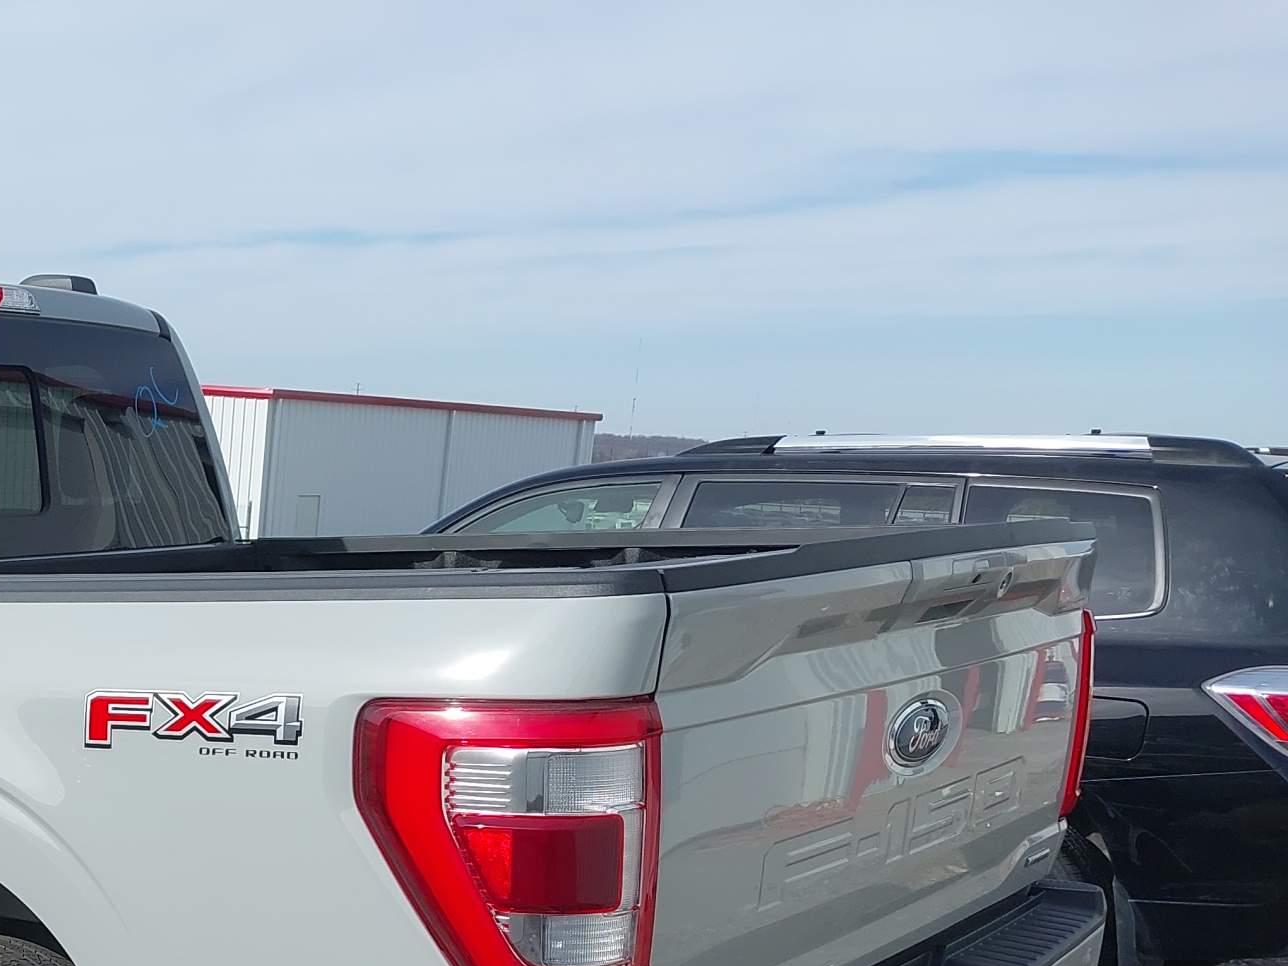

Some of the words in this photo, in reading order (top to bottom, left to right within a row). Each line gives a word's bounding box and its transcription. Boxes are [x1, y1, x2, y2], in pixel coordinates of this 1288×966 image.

[84, 689, 304, 749] FX4
[908, 715, 944, 753] Ford
[198, 746, 238, 757] OFF
[245, 748, 299, 761] ROAD
